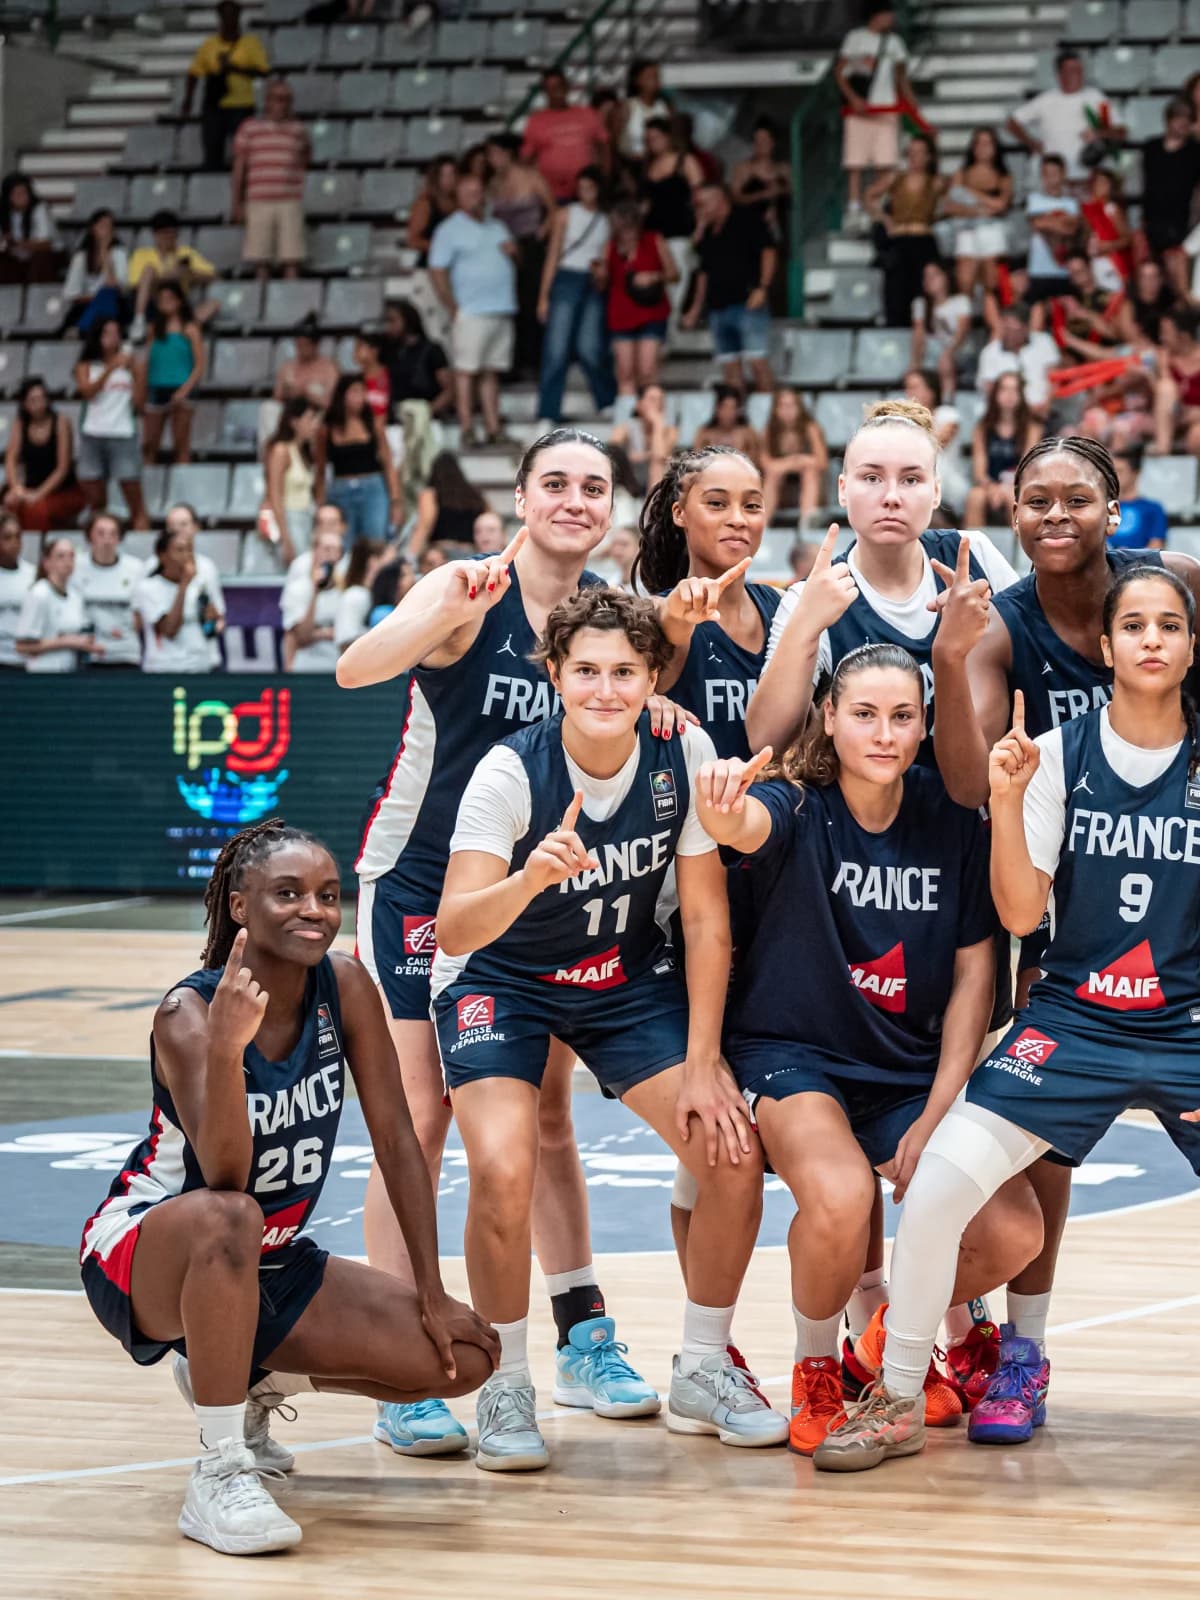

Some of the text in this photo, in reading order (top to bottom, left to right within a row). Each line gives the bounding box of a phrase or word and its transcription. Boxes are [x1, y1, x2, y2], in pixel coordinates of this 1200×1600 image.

[481, 673, 561, 722] FRA
[830, 861, 941, 912] RANCE
[1119, 873, 1153, 922] 9
[582, 894, 631, 936] 11
[395, 966, 431, 976] D'EPAR
[555, 956, 622, 983] MAIF
[1088, 972, 1160, 998] MAIF
[450, 1033, 505, 1053] D'EPARGNE
[458, 1025, 493, 1040] CAISSE
[985, 1060, 1043, 1086] D'EPARGNE
[246, 1062, 341, 1136] RANCE
[254, 1136, 323, 1193] 26
[262, 1225, 299, 1247] AIF
